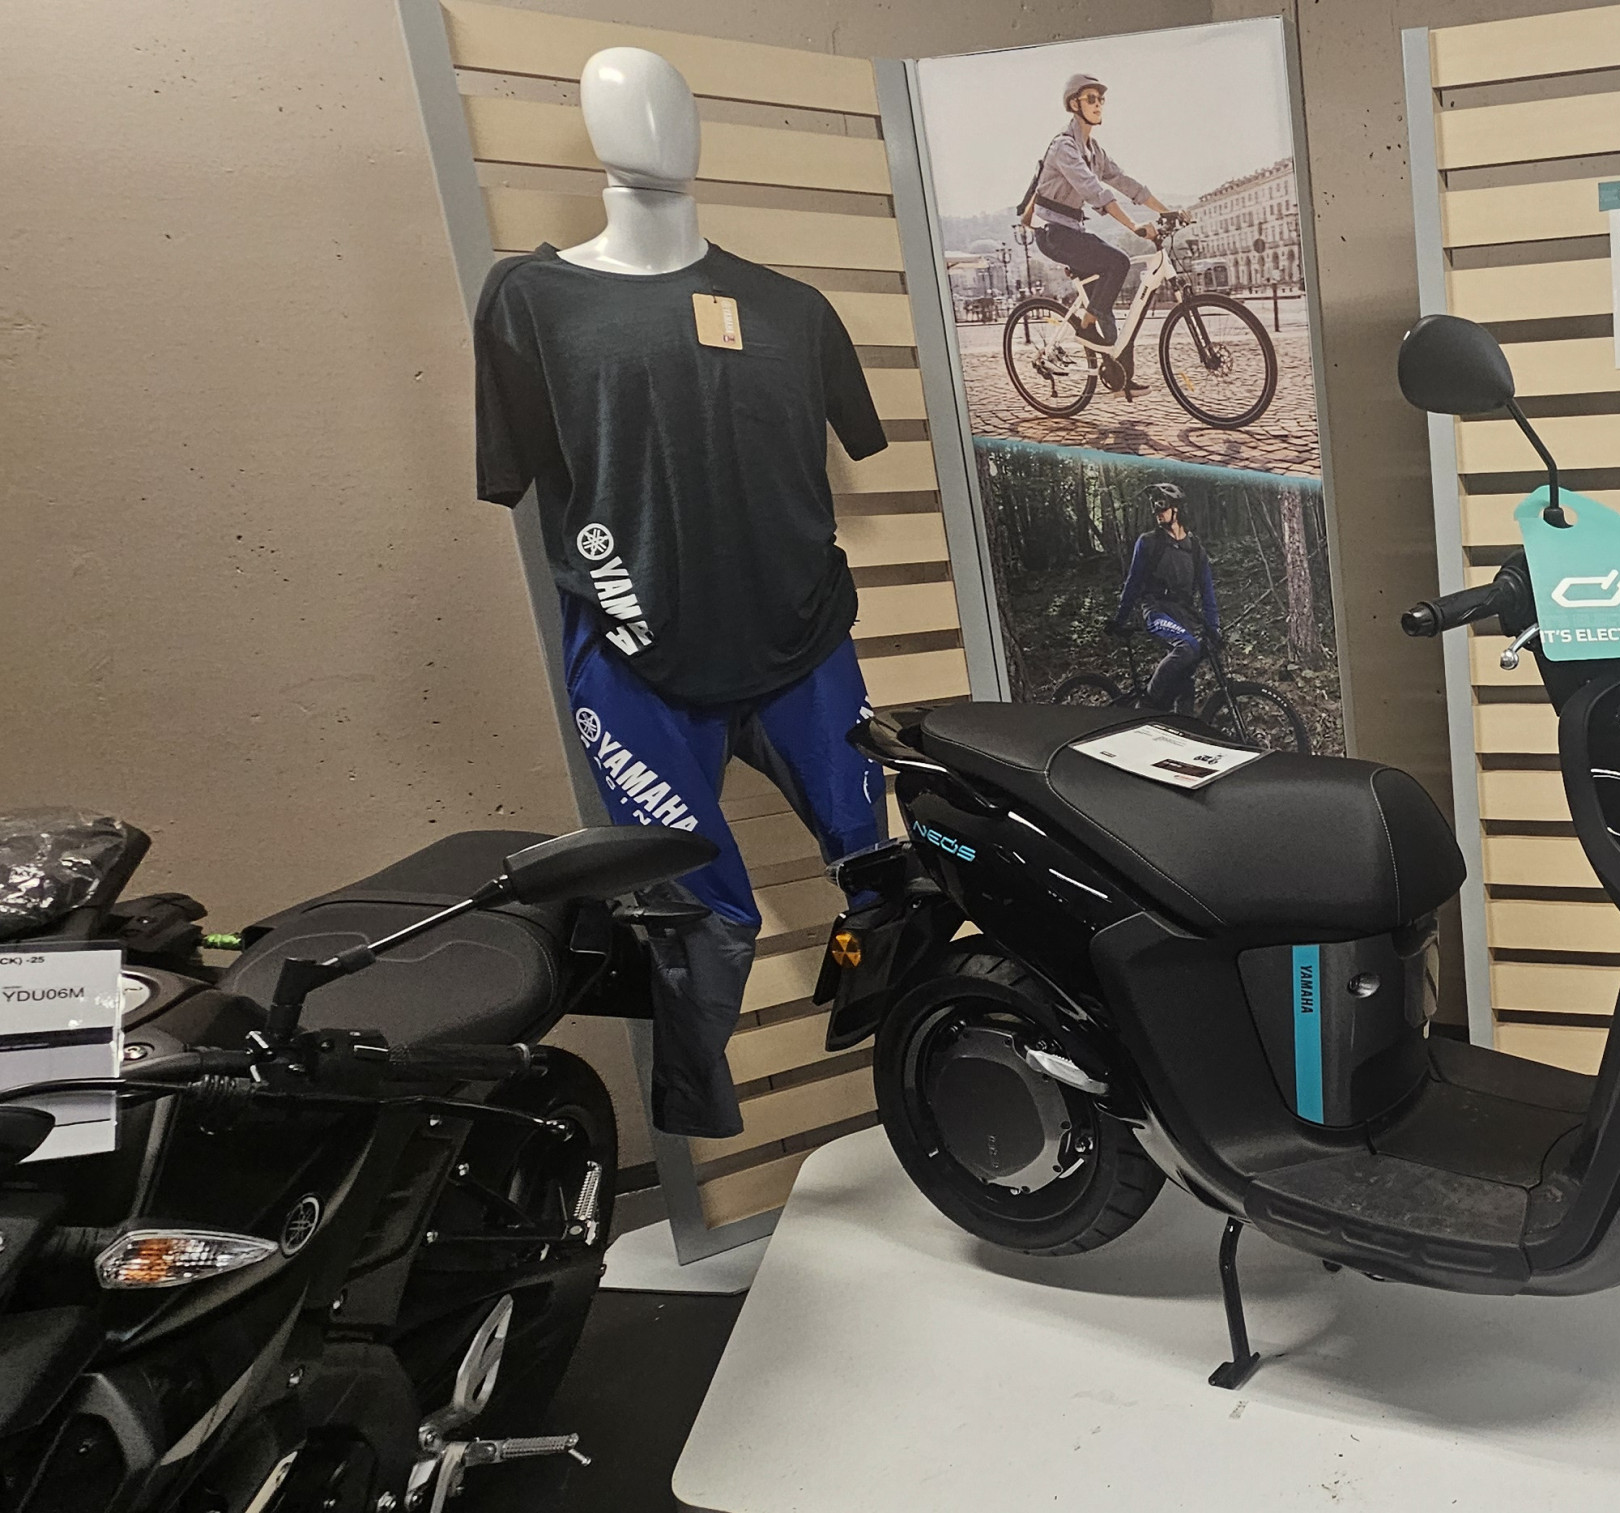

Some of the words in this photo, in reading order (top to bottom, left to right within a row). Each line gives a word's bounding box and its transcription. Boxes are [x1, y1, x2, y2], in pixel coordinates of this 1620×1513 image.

[1539, 629, 1573, 644] IT'S
[2, 986, 85, 1002] YDU06M
[1300, 965, 1314, 1014] YAMAHA
